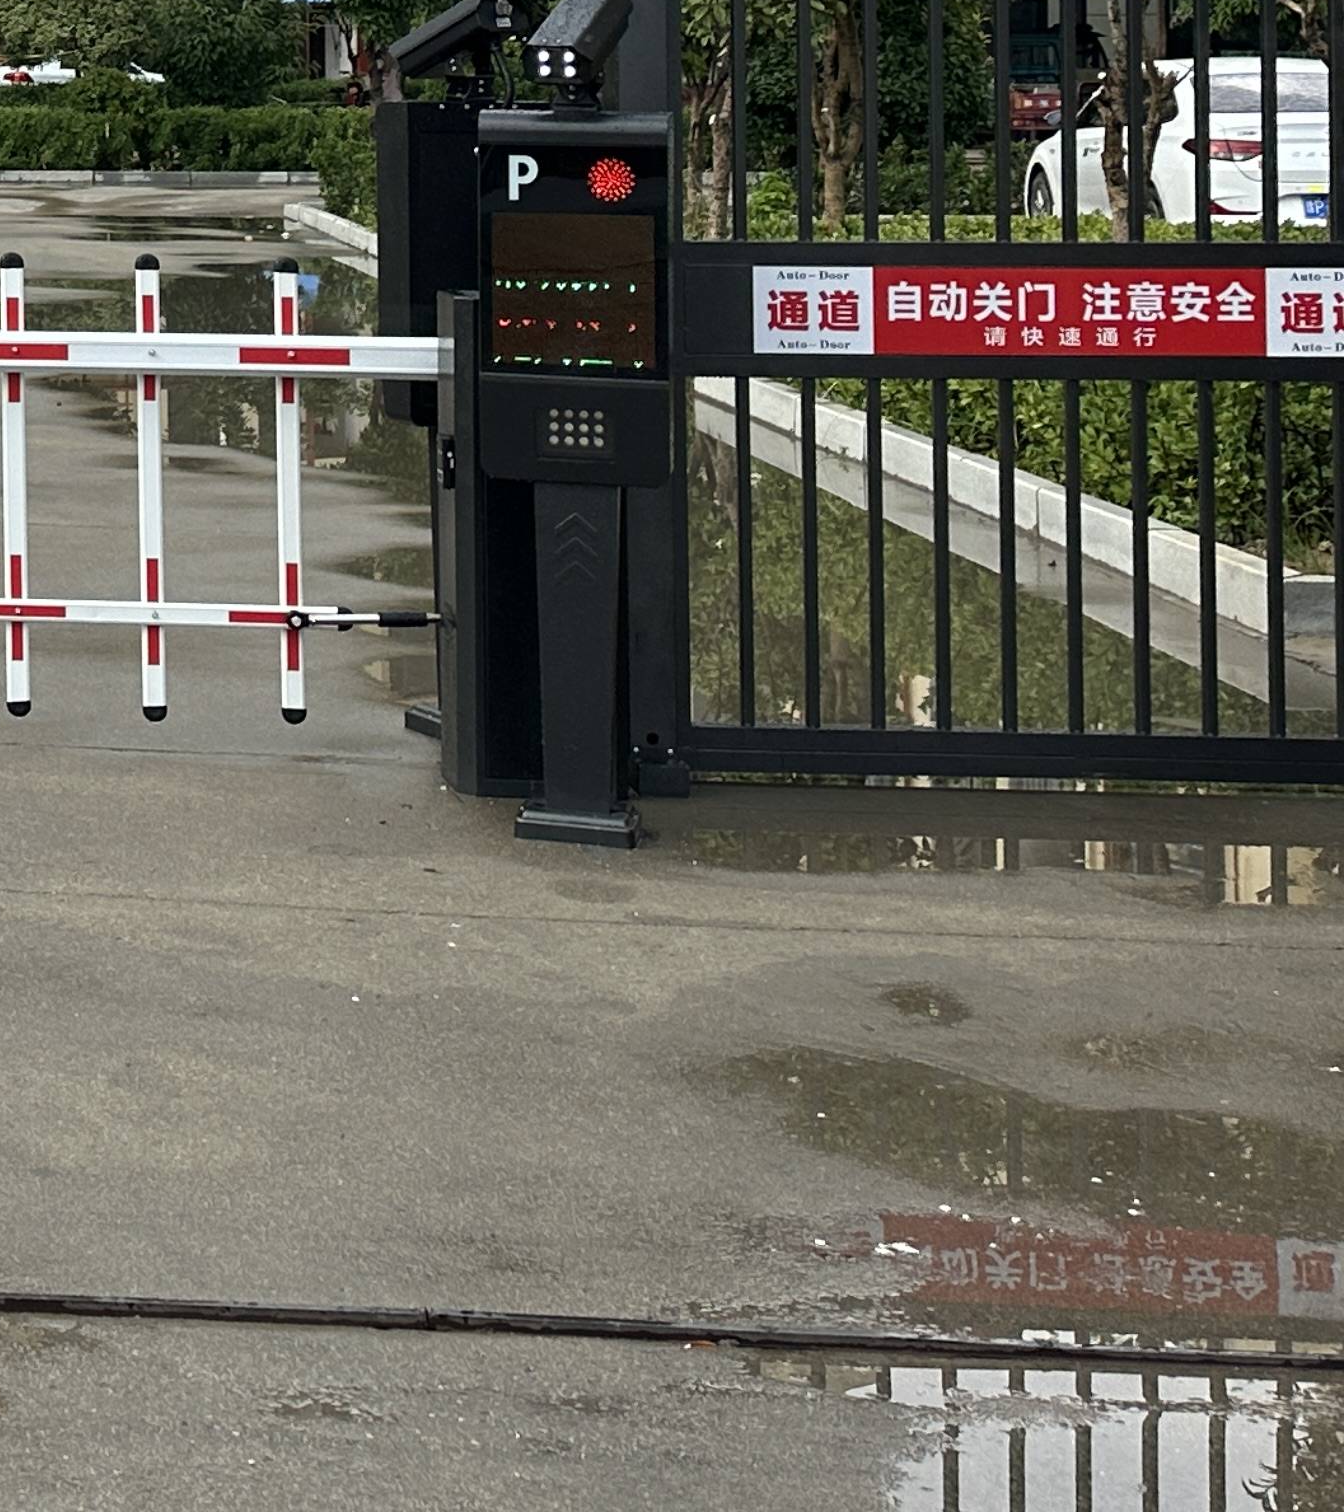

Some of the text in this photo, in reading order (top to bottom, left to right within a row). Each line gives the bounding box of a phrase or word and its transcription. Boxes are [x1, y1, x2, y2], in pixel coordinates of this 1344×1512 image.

[507, 154, 539, 201] P
[767, 289, 860, 332] 通道
[886, 280, 1257, 322] 自动关门 注意安全
[1280, 291, 1344, 334] 通
[983, 326, 1158, 348] 请快速通行
